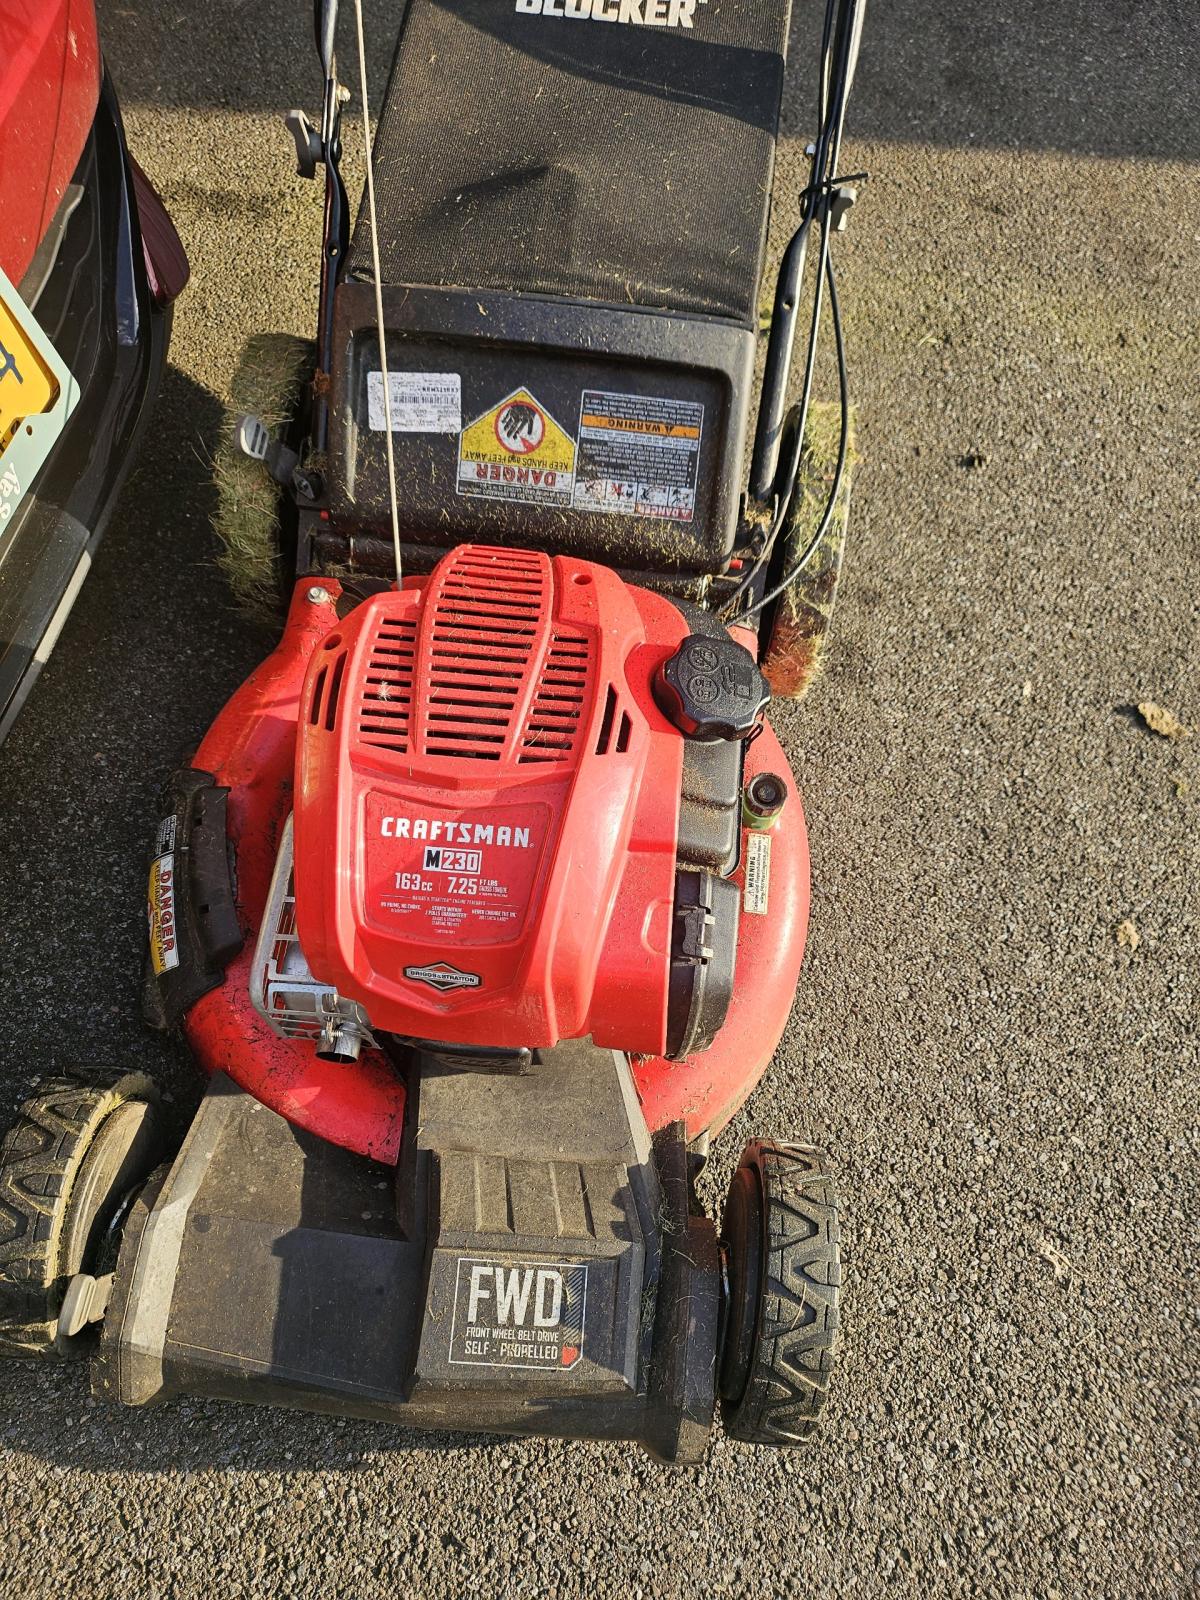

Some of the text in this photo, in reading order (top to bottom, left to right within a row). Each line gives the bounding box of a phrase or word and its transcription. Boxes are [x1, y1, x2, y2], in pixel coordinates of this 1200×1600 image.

[607, 419, 661, 433] WARNING
[522, 457, 547, 468] HANDS
[548, 461, 568, 471] KEEP
[476, 463, 557, 487] DANGER
[381, 817, 531, 848] CRAFTSMAN
[426, 849, 479, 872] M230
[748, 856, 756, 887] WARNING
[447, 876, 478, 895] 7.25
[160, 870, 175, 952] DANGER
[467, 1266, 563, 1327] FWD
[466, 1326, 559, 1343] FRONT WHEEL BELT DRIVE
[464, 1341, 490, 1355] SELF
[500, 1343, 559, 1360] PROPELLED
